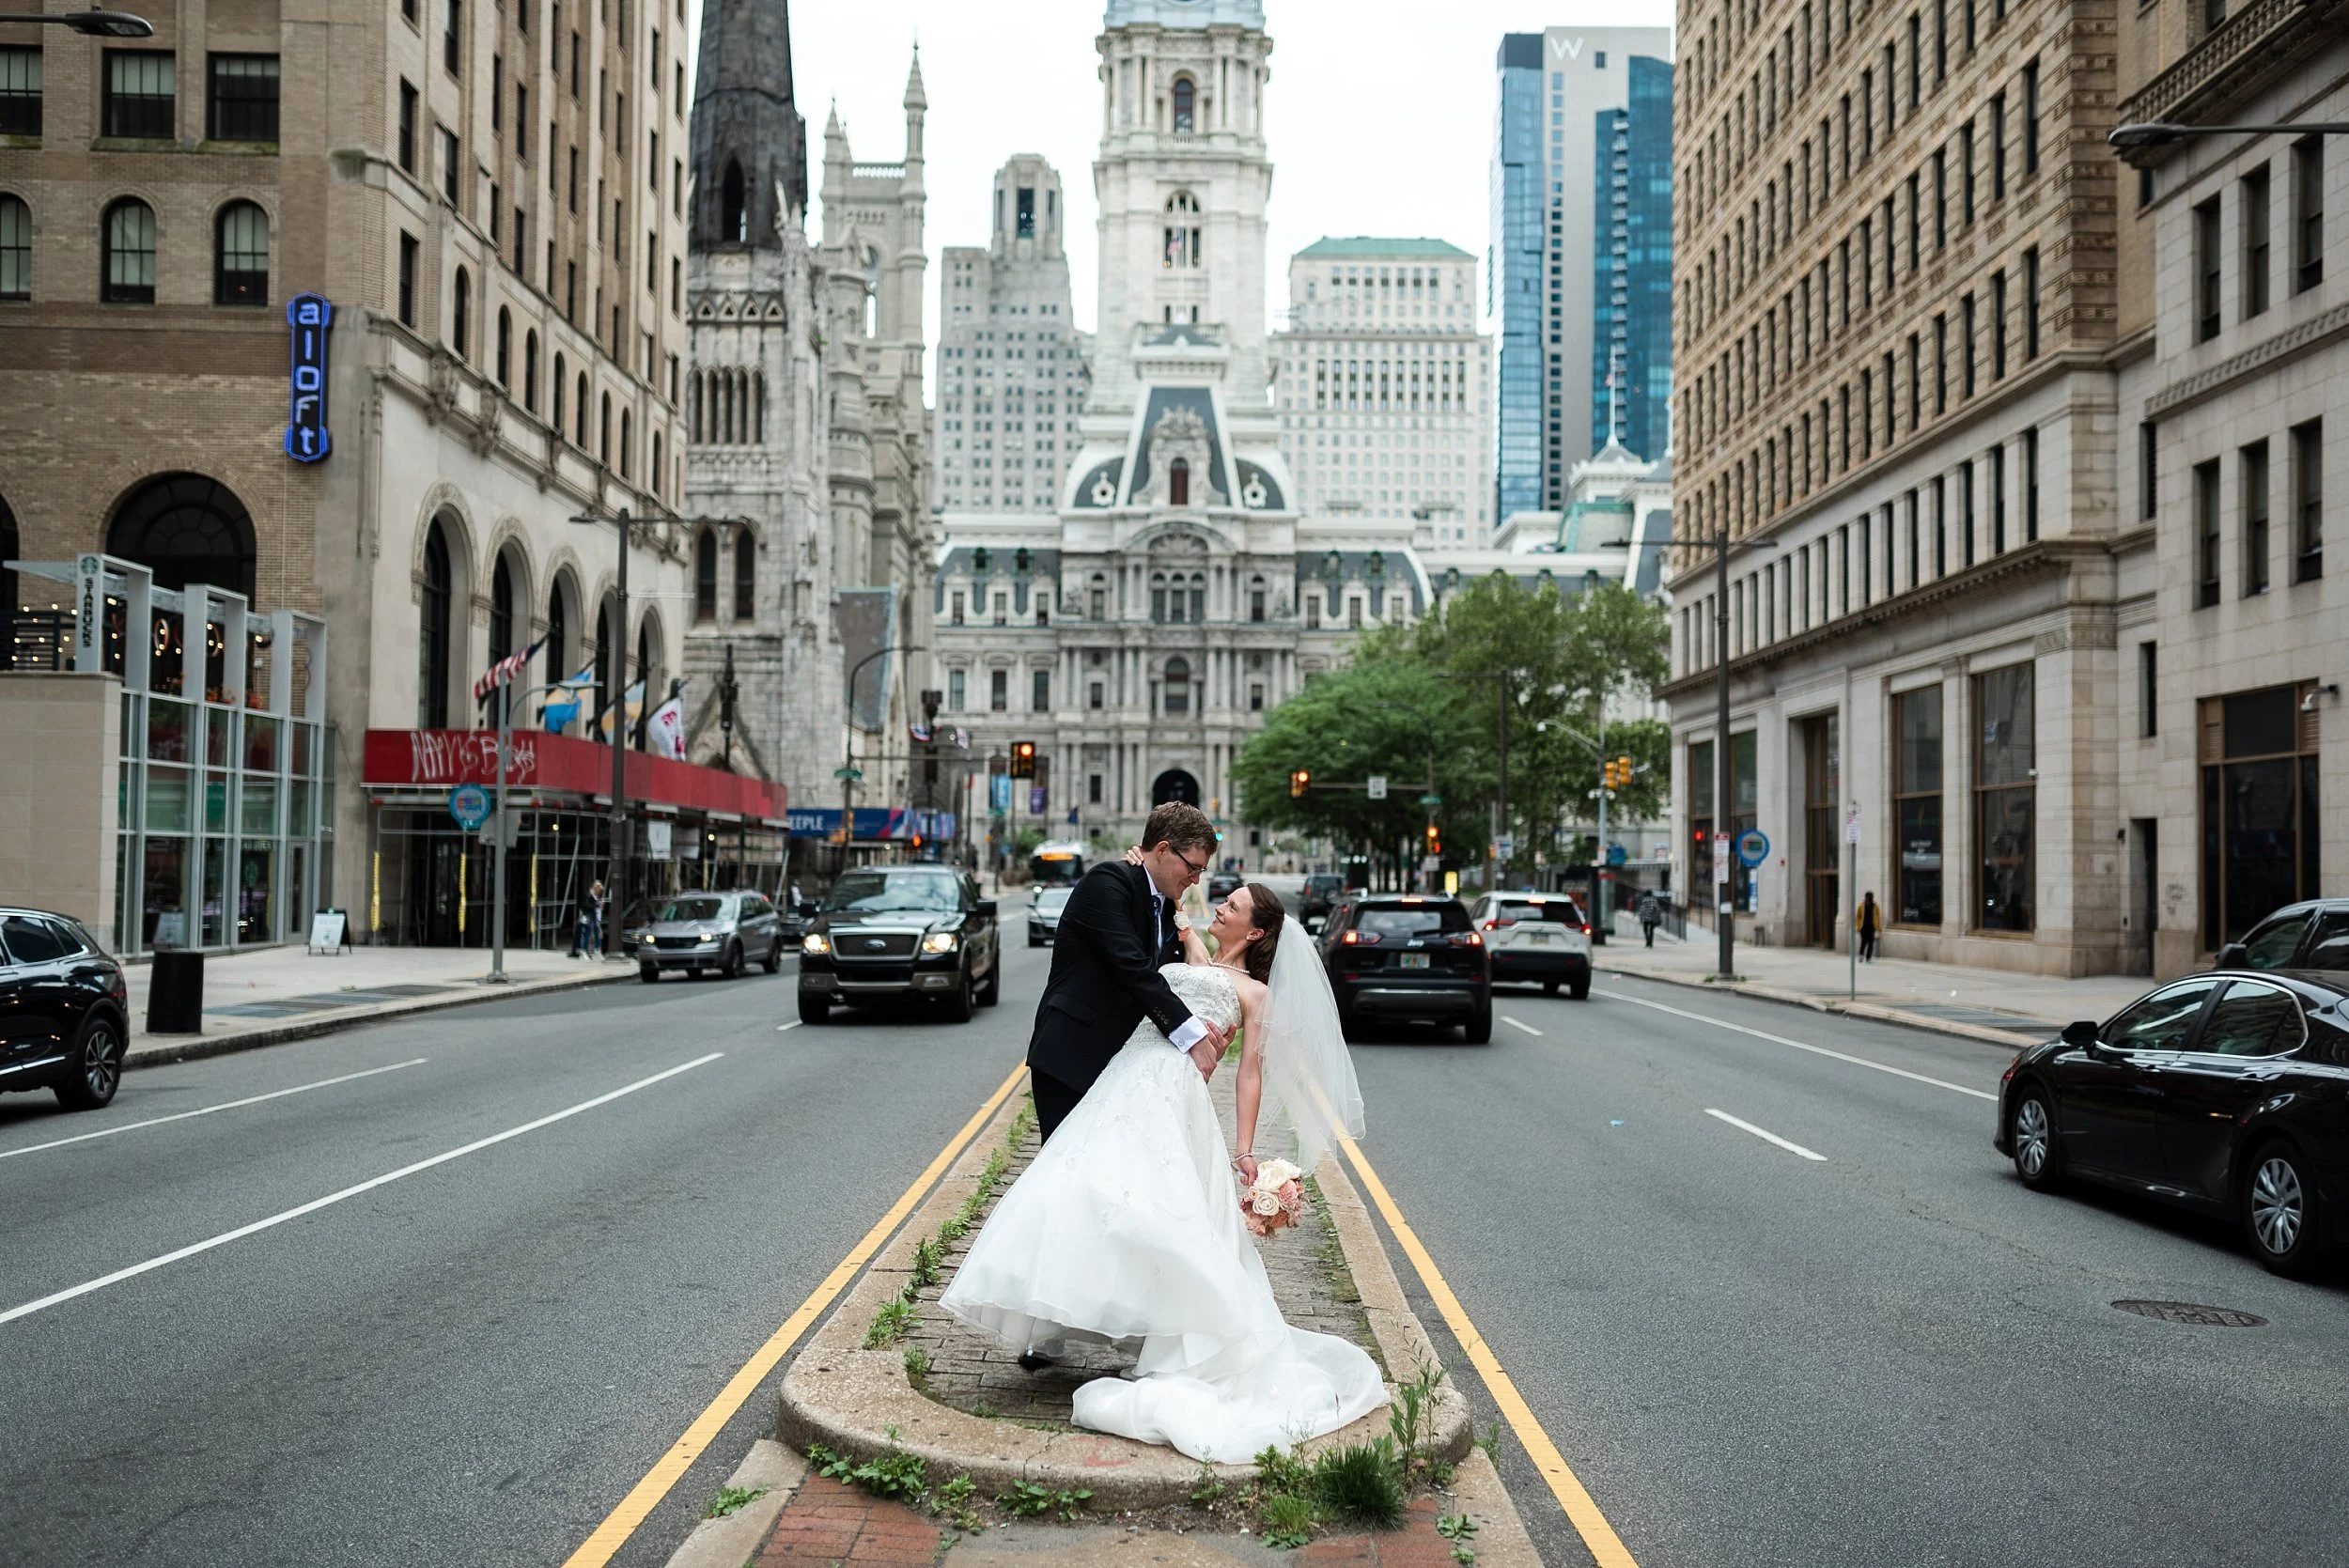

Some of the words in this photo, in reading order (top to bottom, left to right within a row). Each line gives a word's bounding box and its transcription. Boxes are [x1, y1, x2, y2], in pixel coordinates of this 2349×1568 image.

[1550, 37, 1585, 60] W
[296, 302, 320, 455] aloft
[83, 577, 93, 647] STARBUCKS
